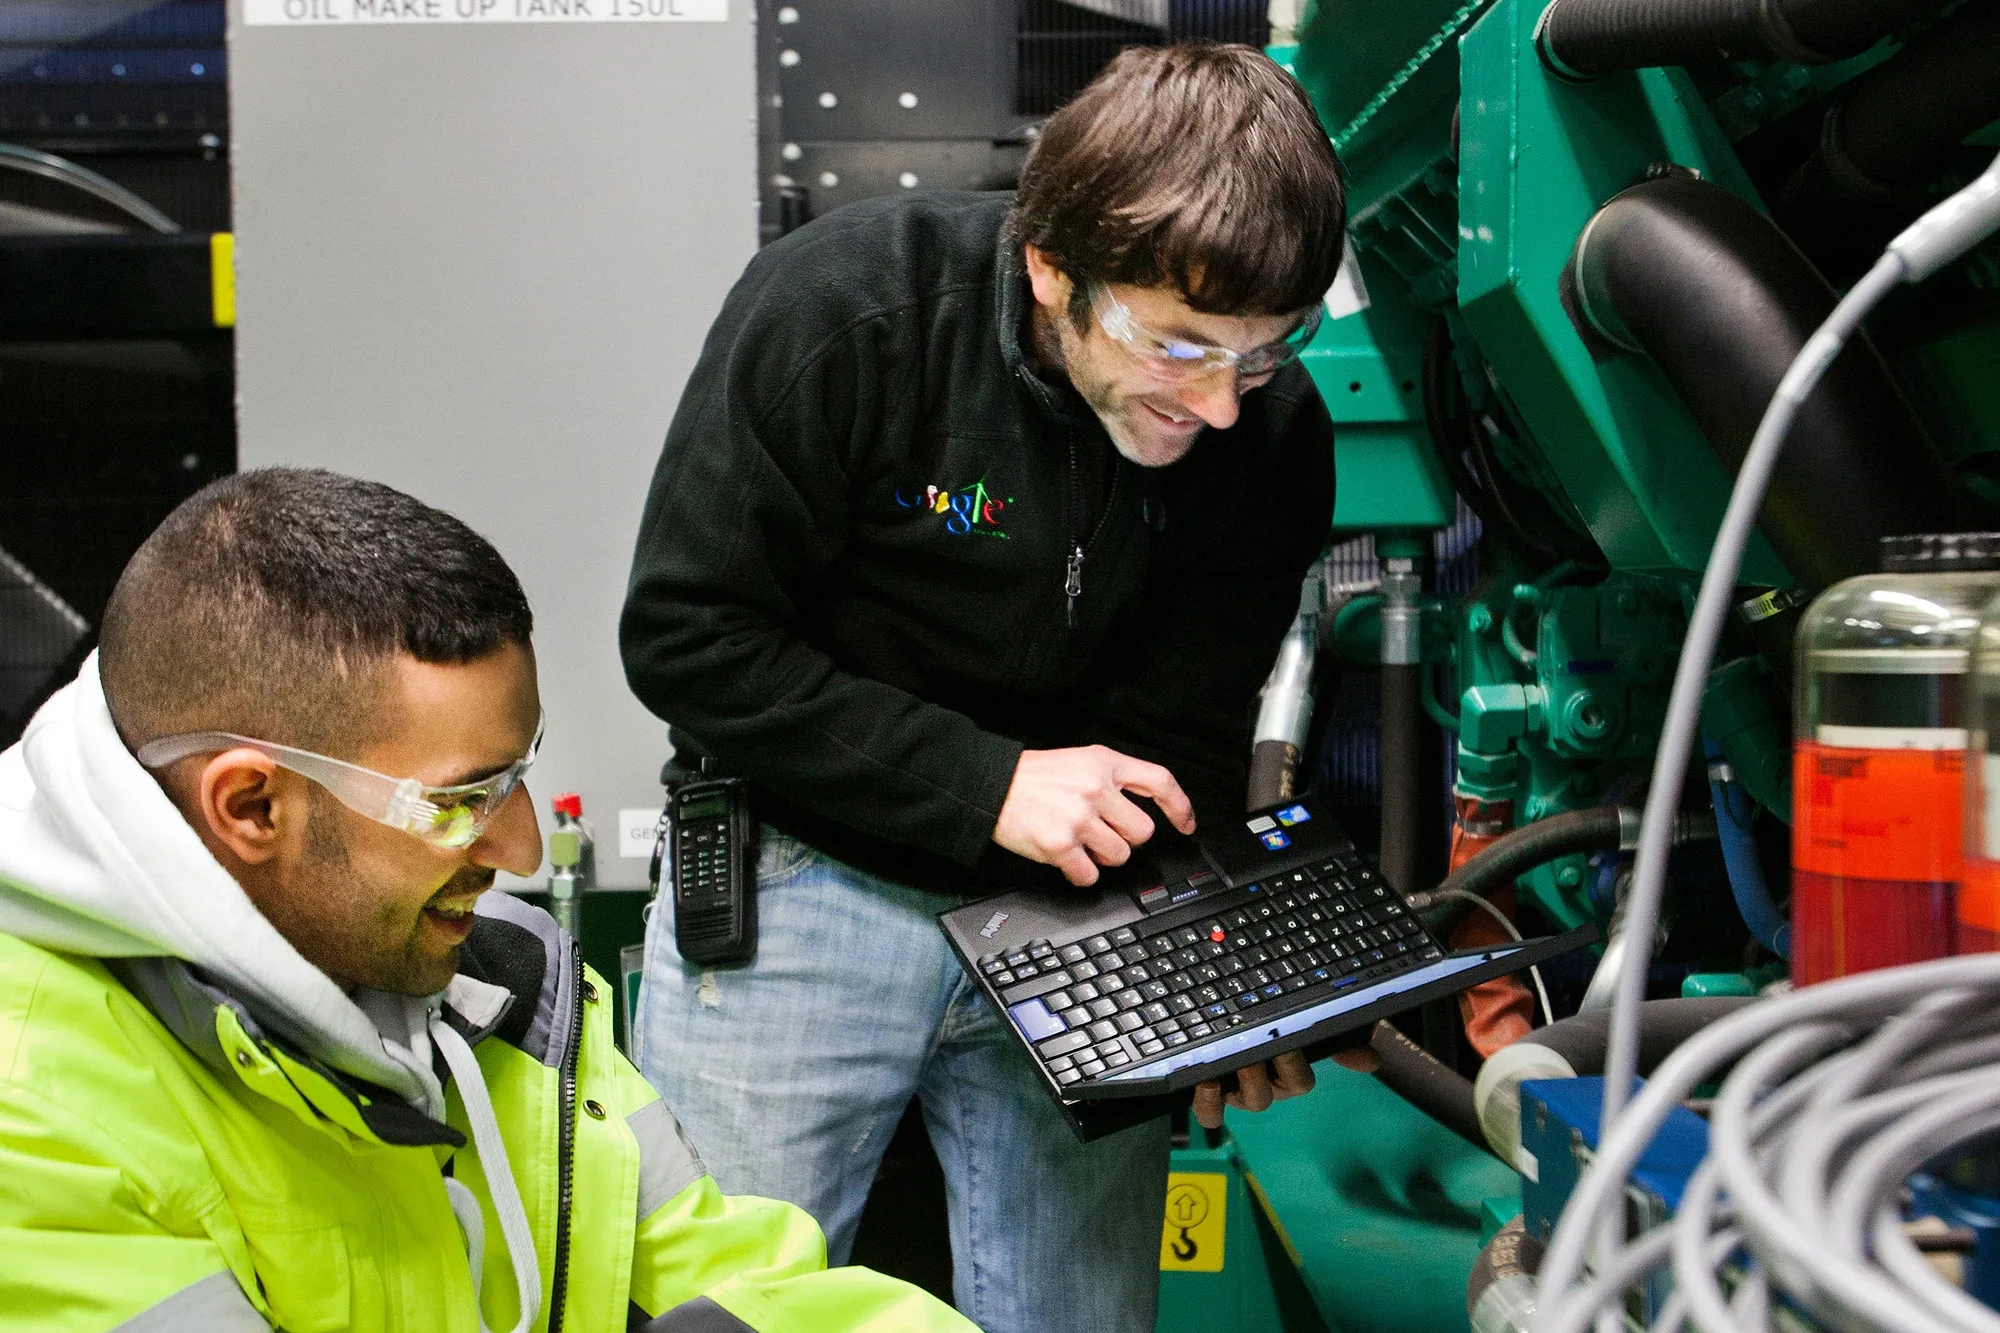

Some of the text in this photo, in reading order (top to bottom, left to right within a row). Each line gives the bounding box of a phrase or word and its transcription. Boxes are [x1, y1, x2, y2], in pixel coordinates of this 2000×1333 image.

[283, 0, 341, 19] OIL
[353, 0, 442, 18] MAKE
[456, 0, 497, 18] UP
[512, 0, 593, 17] TANK
